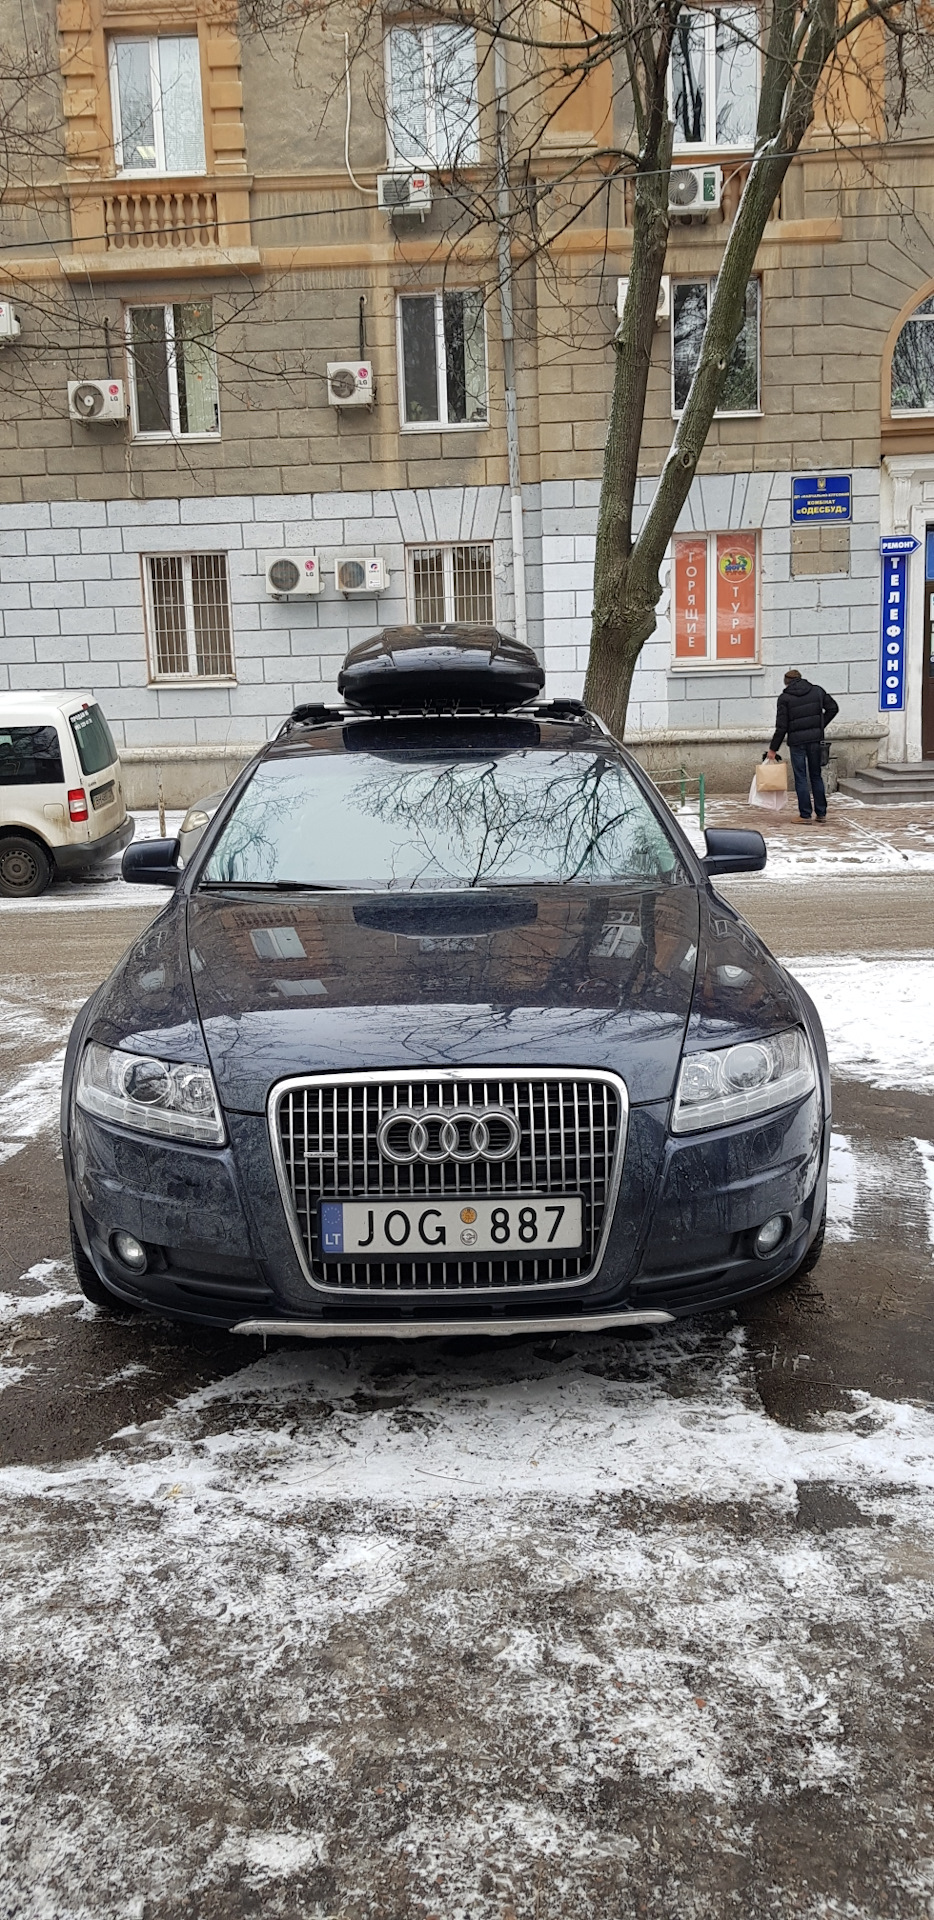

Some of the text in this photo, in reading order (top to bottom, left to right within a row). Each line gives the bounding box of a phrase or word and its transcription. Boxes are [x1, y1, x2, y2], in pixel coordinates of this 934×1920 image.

[796, 505, 847, 515] «ОДЕСБУД»
[882, 541, 915, 550] РЕМОНТ
[685, 552, 698, 648] ГОРЯЩИЕ
[730, 586, 741, 645] ТУРЫ
[886, 557, 901, 705] ТЕЛЕФОНОВ
[325, 1233, 341, 1245] LT
[358, 1205, 565, 1246] JOG 887
